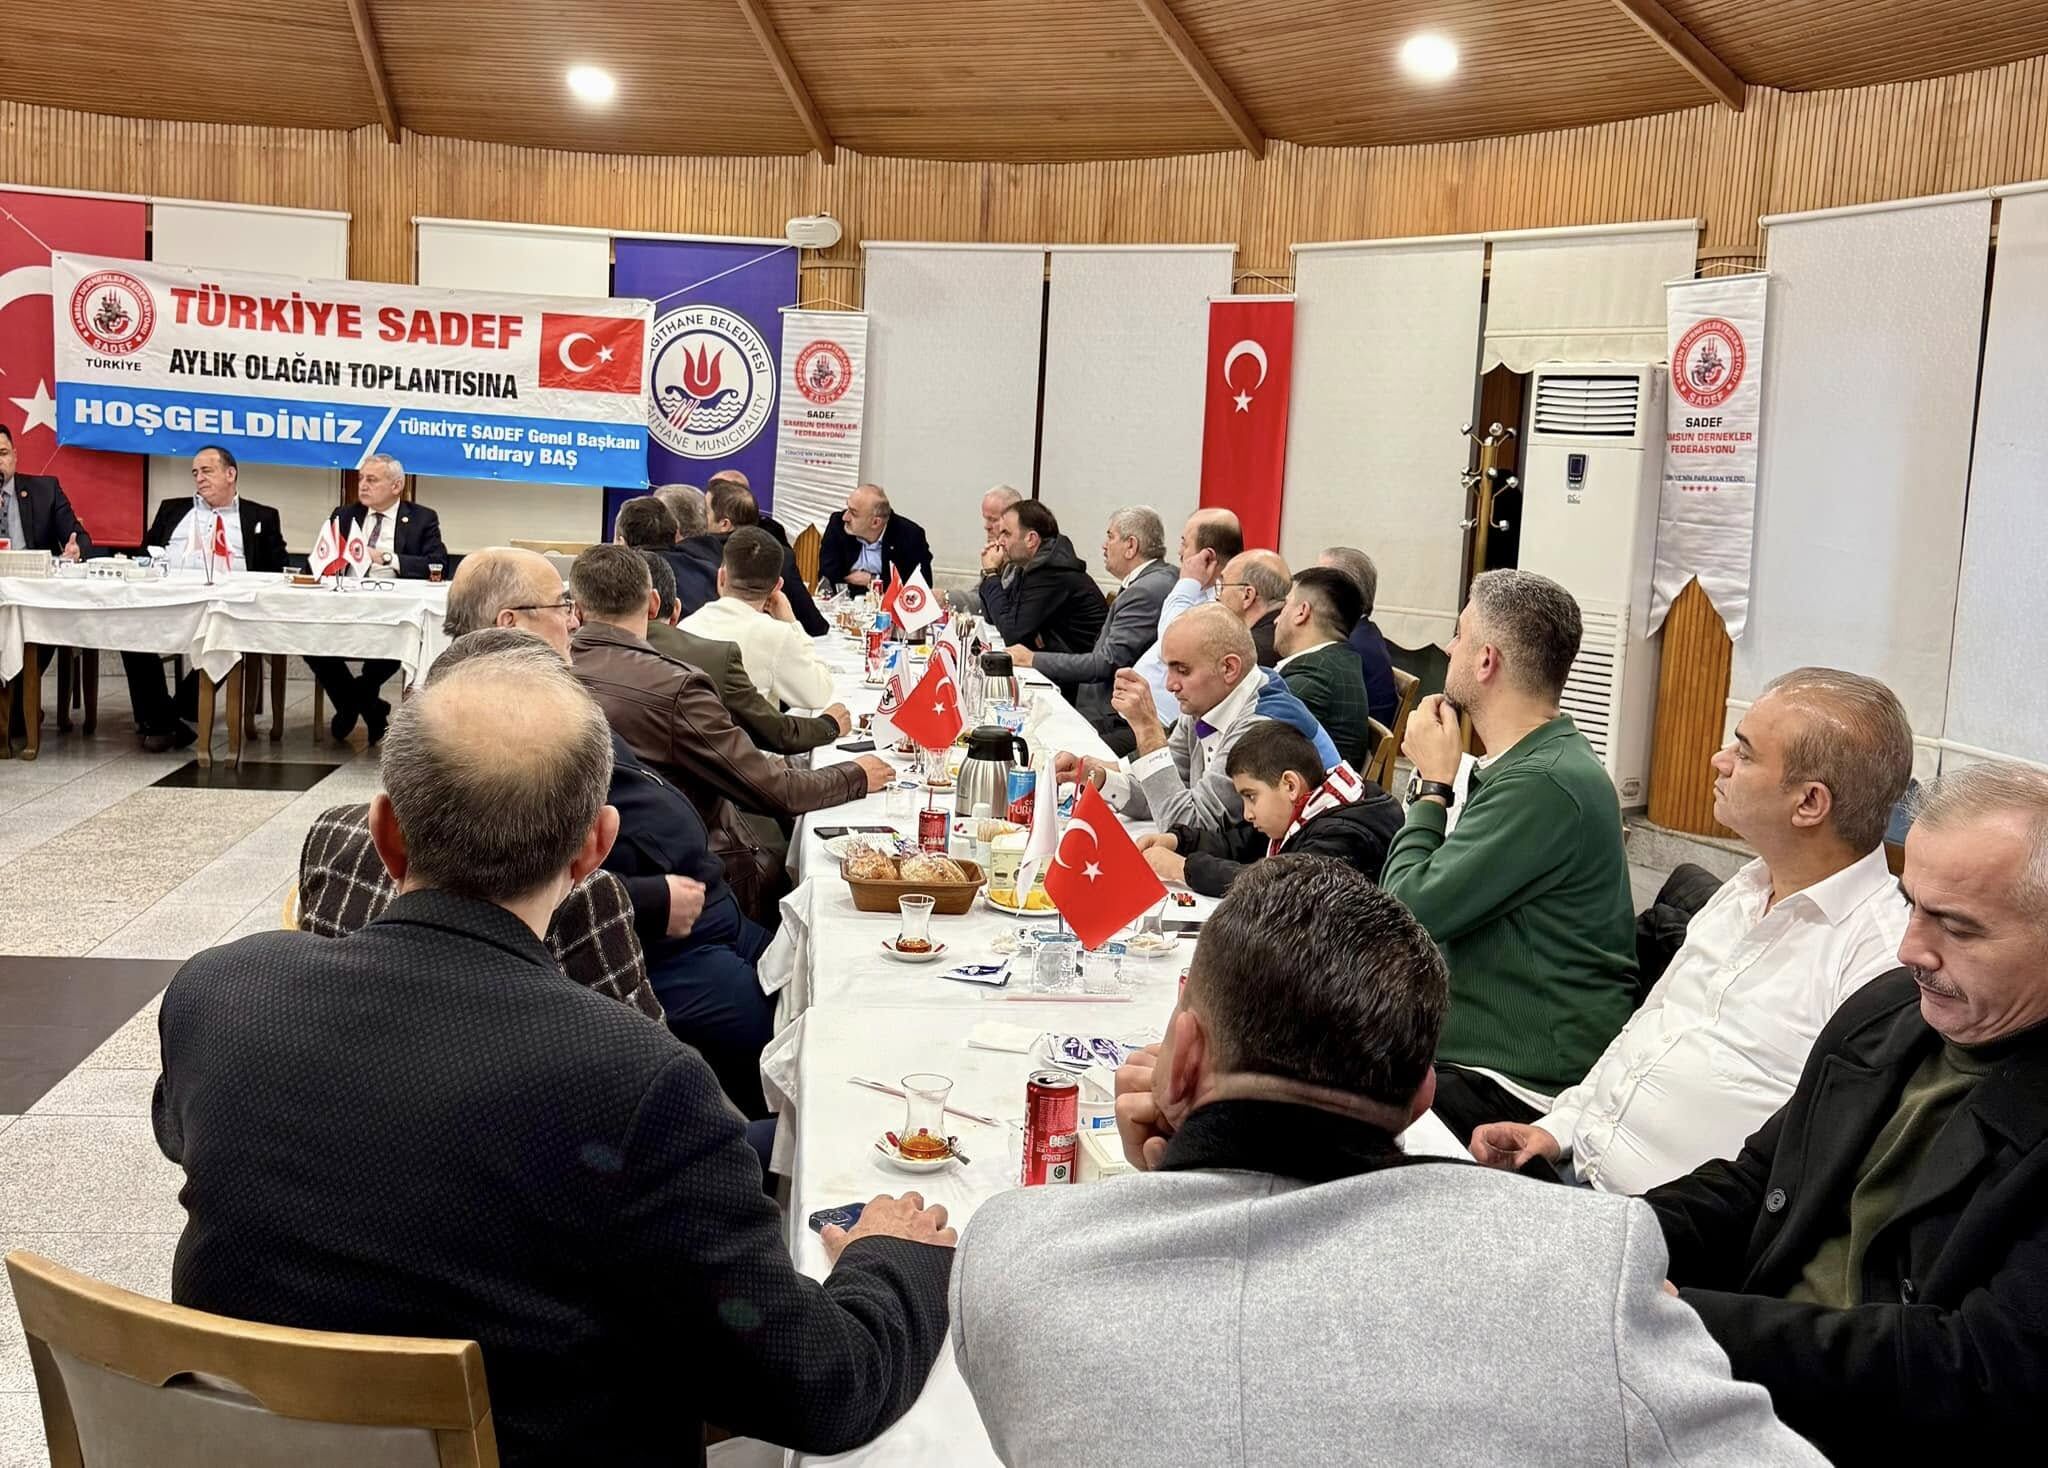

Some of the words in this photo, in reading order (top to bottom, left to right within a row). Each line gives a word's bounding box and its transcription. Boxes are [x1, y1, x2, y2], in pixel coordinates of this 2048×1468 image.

[170, 283, 363, 340] TÜRKİYE
[378, 306, 524, 350] SADEF
[93, 339, 134, 354] SADEF
[85, 357, 142, 371] TÜRKİYE
[168, 347, 237, 378] AYLIK
[245, 351, 341, 388] OLAĞAN
[349, 362, 519, 400] TOPLANTISINA
[1687, 392, 1724, 406] SADEF
[74, 397, 363, 445] HOŞGELDİNİZ
[807, 410, 836, 419] SADEF
[695, 393, 767, 451] MUNICIPALITY
[783, 419, 815, 428] SAMSUN
[816, 422, 858, 430] DERNEKLER
[1685, 416, 1723, 428] SADEF
[398, 418, 467, 439] TÜRKİYE
[471, 424, 524, 443] SADEF
[528, 428, 573, 446] Genel
[576, 432, 640, 452] Başkanı
[794, 429, 846, 439] FEDERASYONU
[1697, 432, 1752, 441] DERNEKLER
[1671, 444, 1736, 454] FEDERASYONU
[462, 442, 534, 467] Yıldıray
[539, 447, 578, 471] BAŞ
